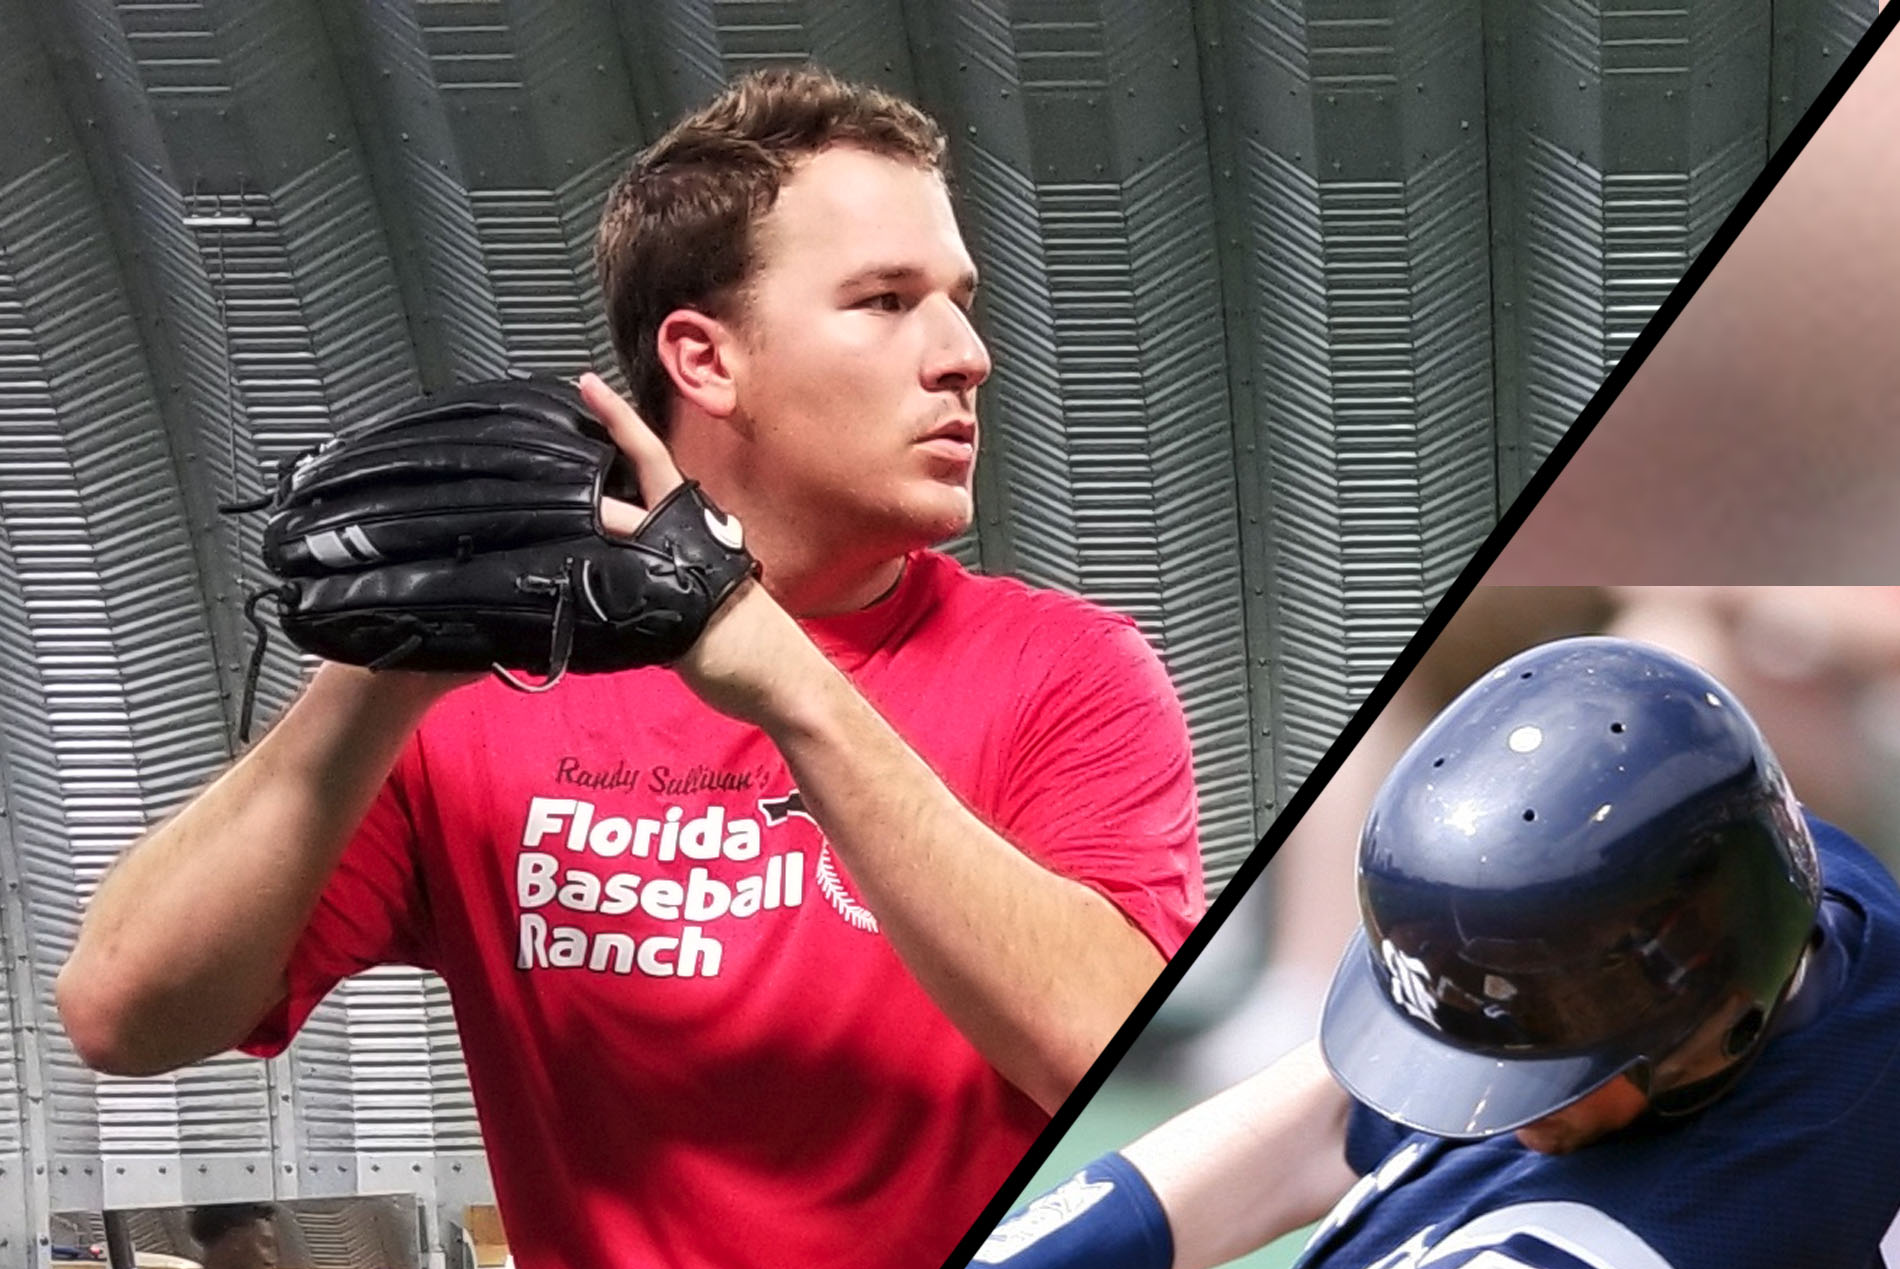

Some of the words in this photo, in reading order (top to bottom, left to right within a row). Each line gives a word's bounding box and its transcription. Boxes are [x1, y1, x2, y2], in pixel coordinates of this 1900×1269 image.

[555, 756, 640, 793] Randy
[522, 796, 761, 862] Florida
[516, 851, 804, 922] Baseball
[515, 913, 723, 978] Ranch
